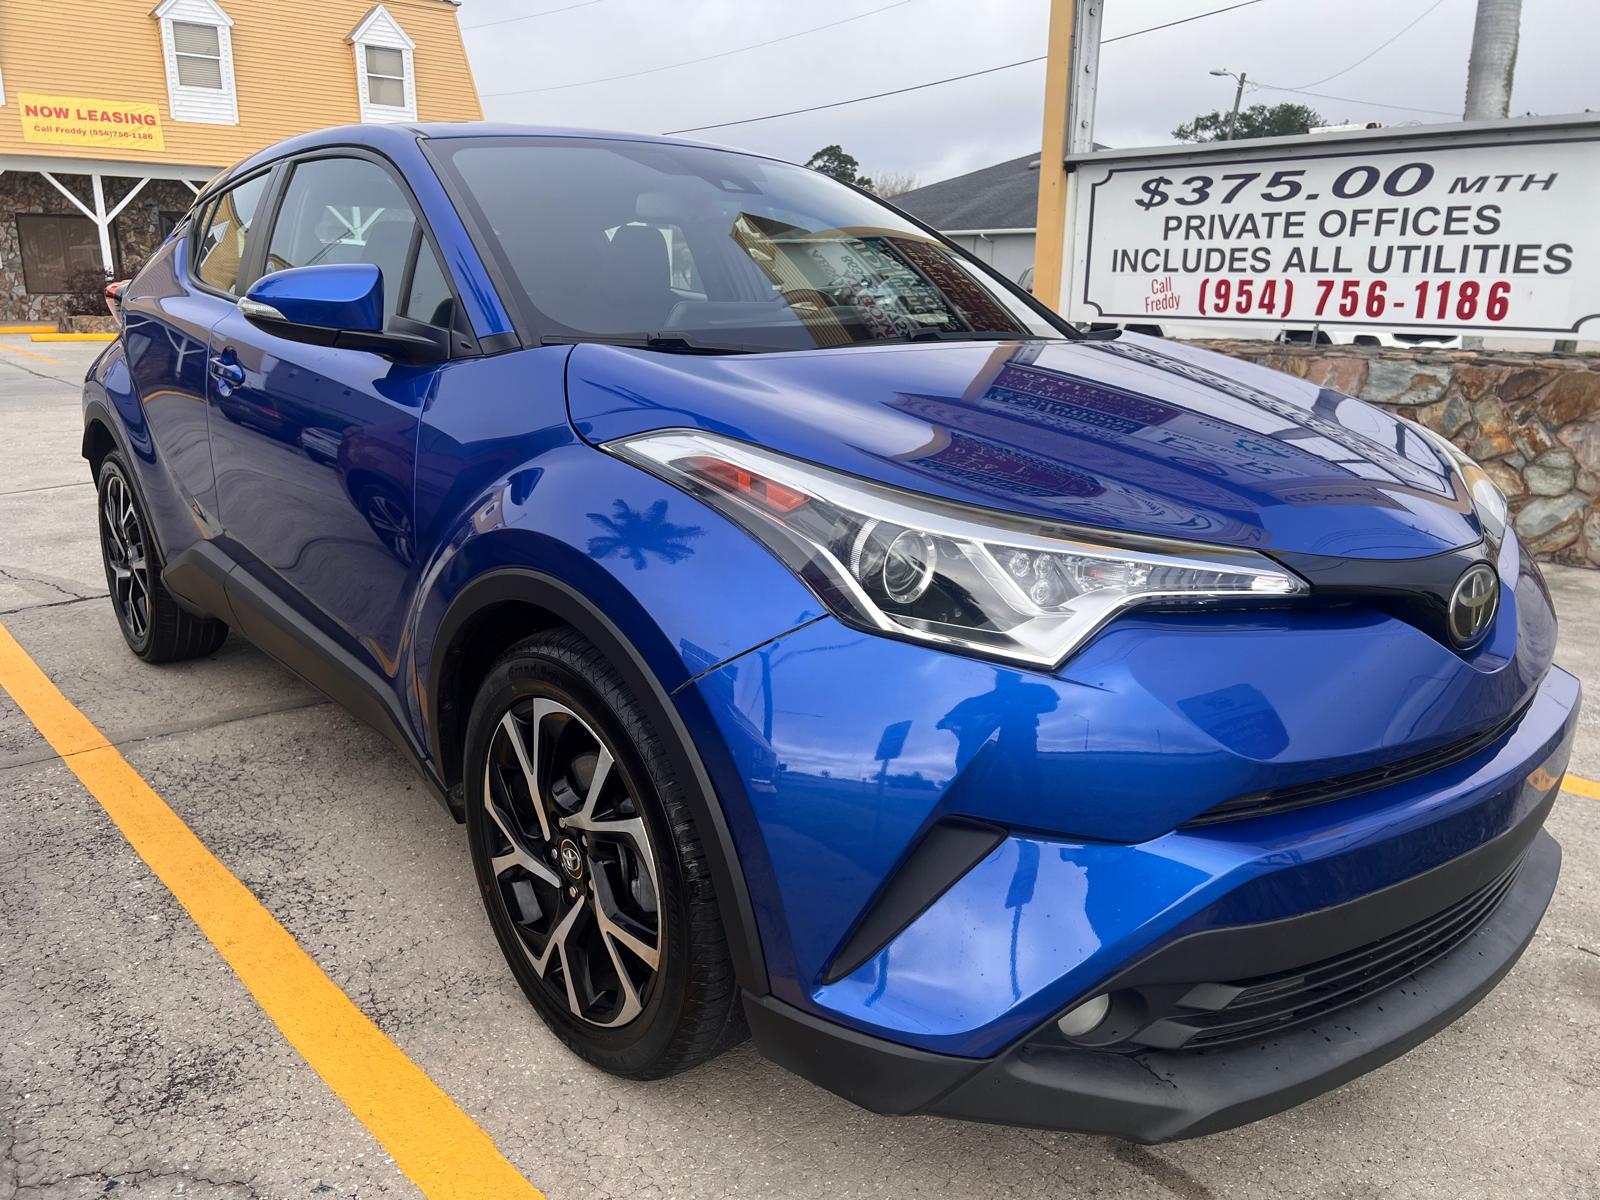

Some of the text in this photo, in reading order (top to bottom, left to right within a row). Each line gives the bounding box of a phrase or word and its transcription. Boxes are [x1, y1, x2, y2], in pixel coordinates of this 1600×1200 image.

[25, 105, 157, 126] NOW LEASING
[34, 125, 53, 133] Call
[55, 126, 87, 136] Freddy
[1135, 162, 1559, 211] $375.00 MTH
[1163, 204, 1502, 241] PRIVATE OFFICES
[1112, 243, 1574, 275] INCLUDES ALL UTILITIES
[1151, 276, 1172, 295] Call
[1145, 293, 1181, 313] Freddy
[1198, 278, 1512, 321] (954) 756-1186
